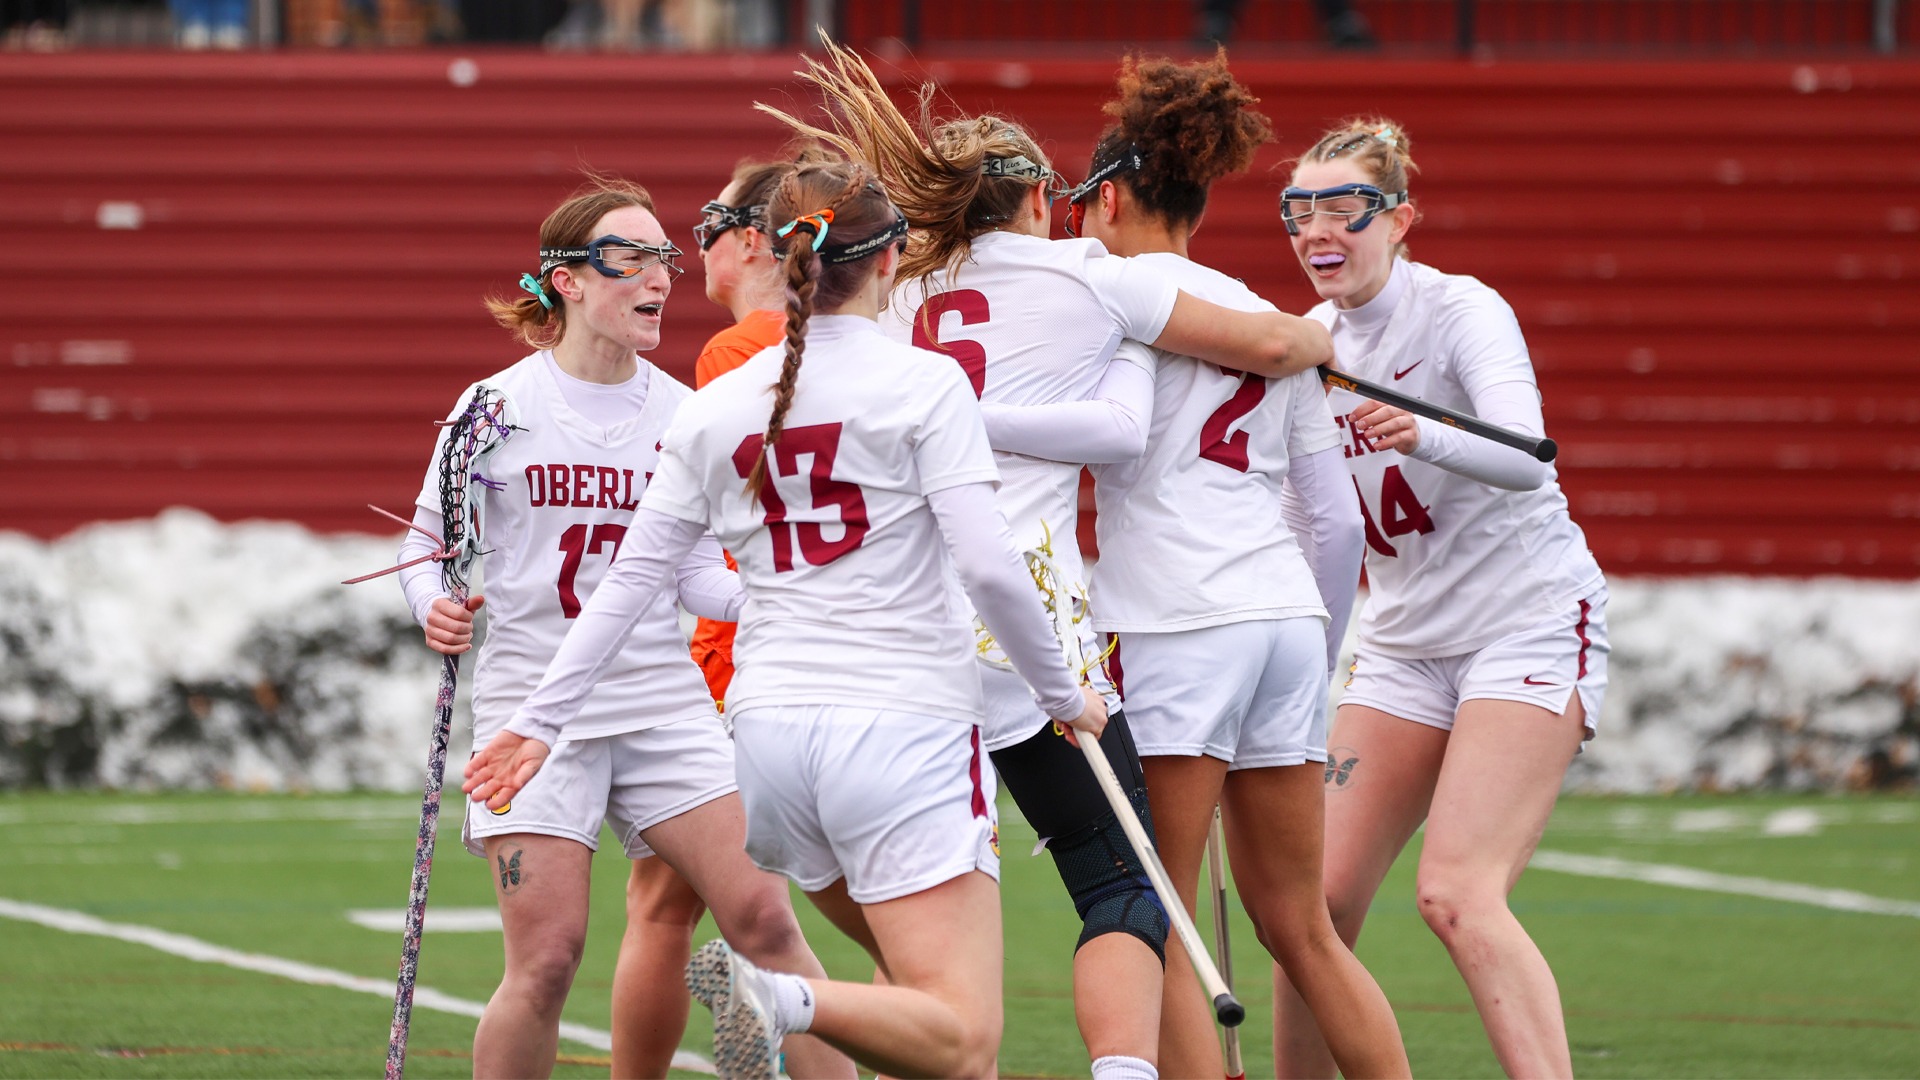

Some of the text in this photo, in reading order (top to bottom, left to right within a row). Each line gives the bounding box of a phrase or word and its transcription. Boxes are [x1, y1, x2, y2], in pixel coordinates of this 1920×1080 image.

[911, 288, 990, 402] 6
[1198, 365, 1267, 473] 2
[731, 421, 871, 574] 13
